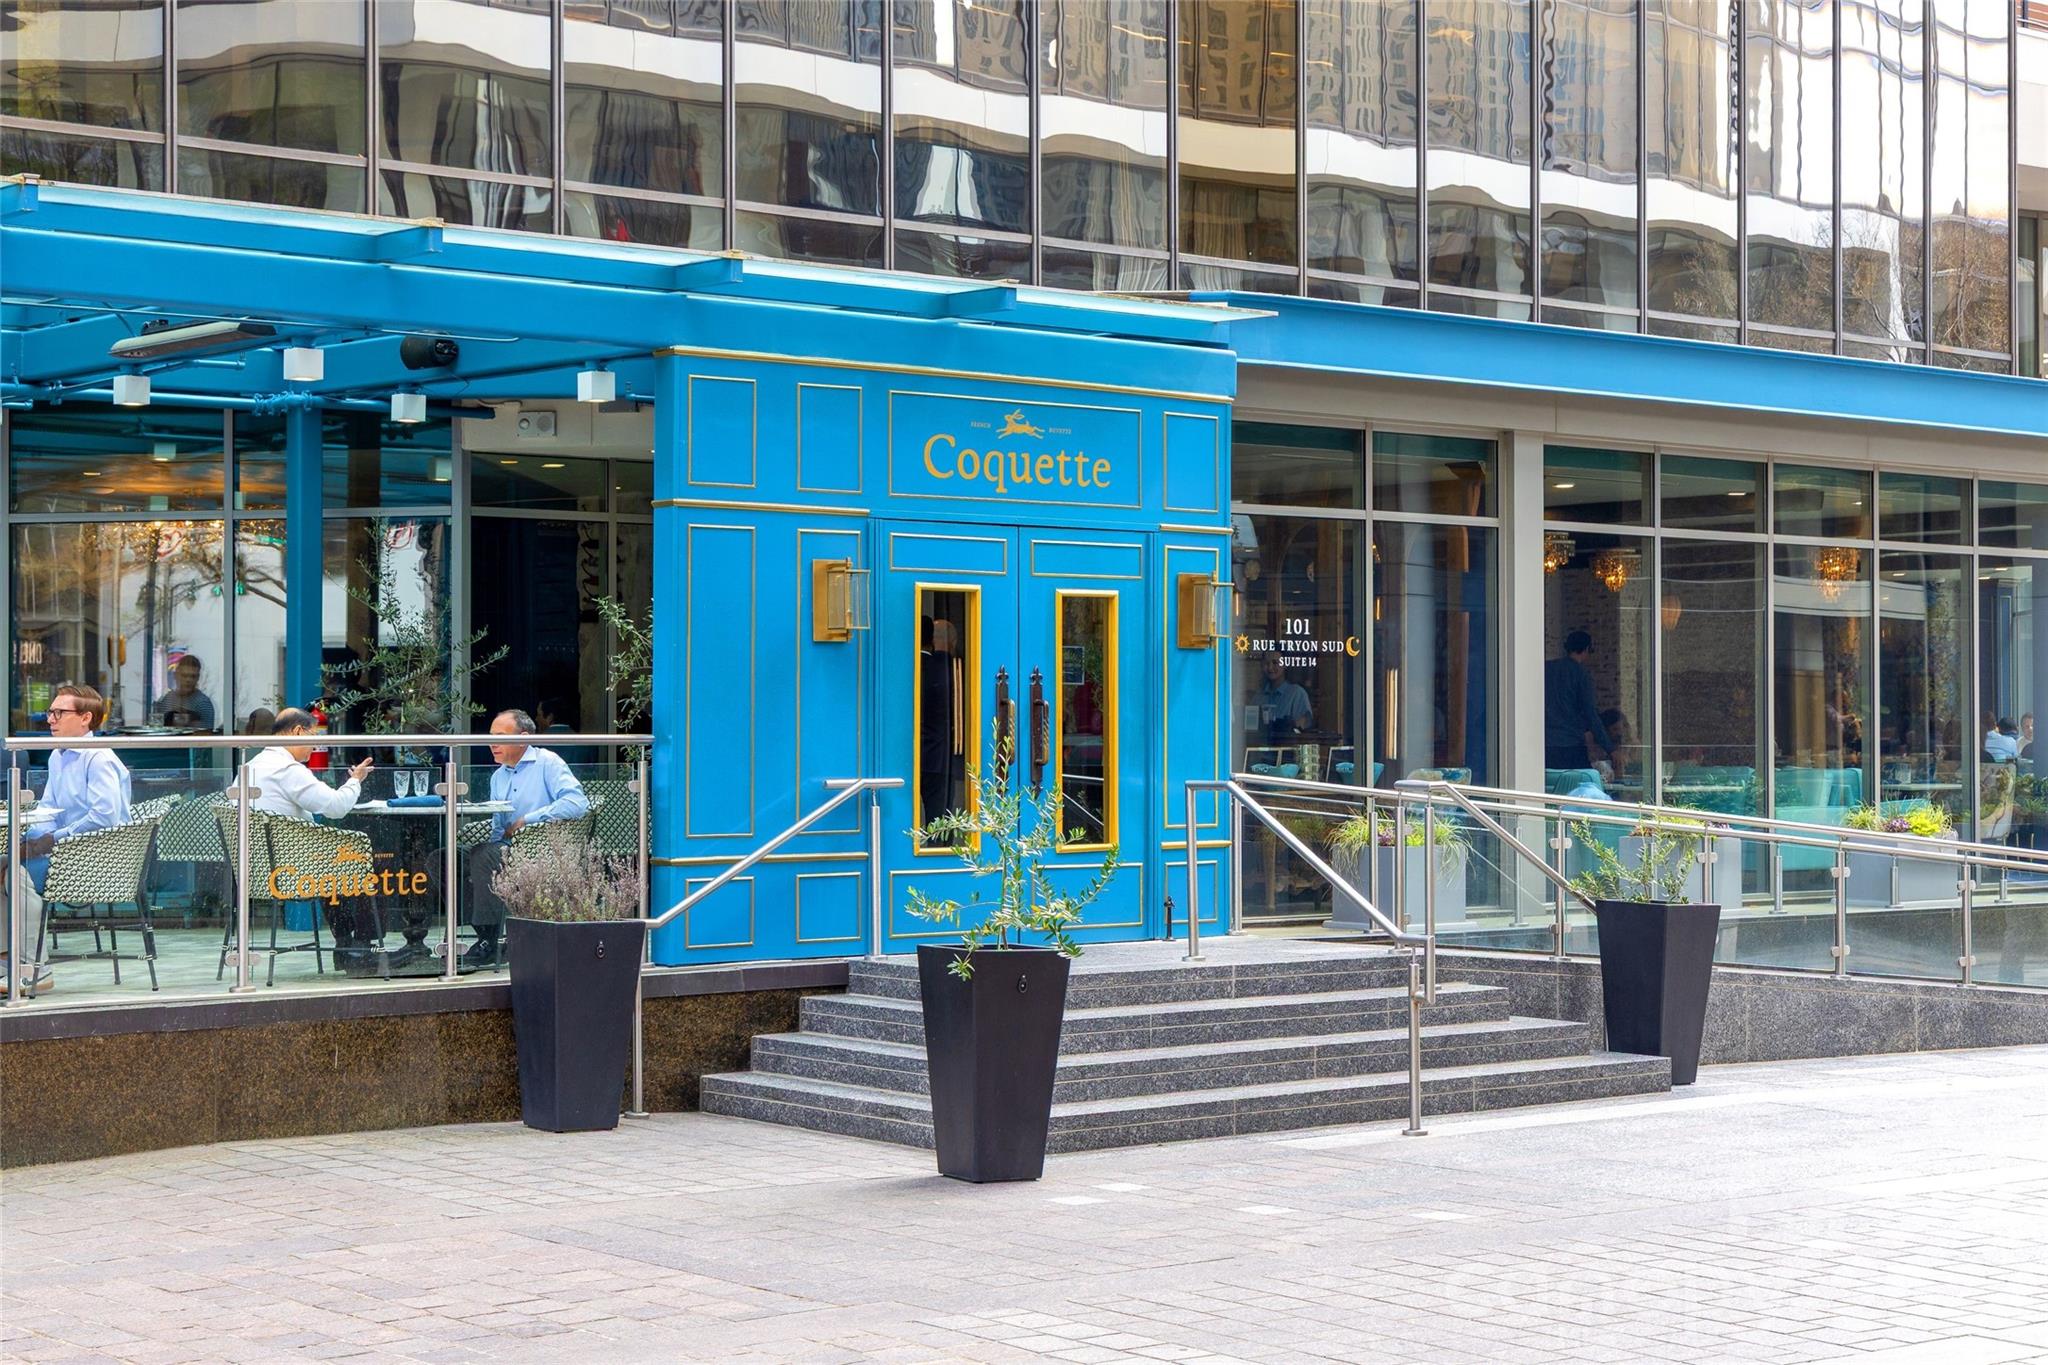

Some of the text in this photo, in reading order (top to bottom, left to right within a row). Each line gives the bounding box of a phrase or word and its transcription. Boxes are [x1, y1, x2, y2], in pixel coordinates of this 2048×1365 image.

[923, 433, 1112, 494] Coquette
[1285, 618, 1311, 635] 101
[1252, 639, 1345, 653] RUE TRYON SUD
[1278, 656, 1317, 668] SUITE 14
[267, 864, 428, 906] Coquette
